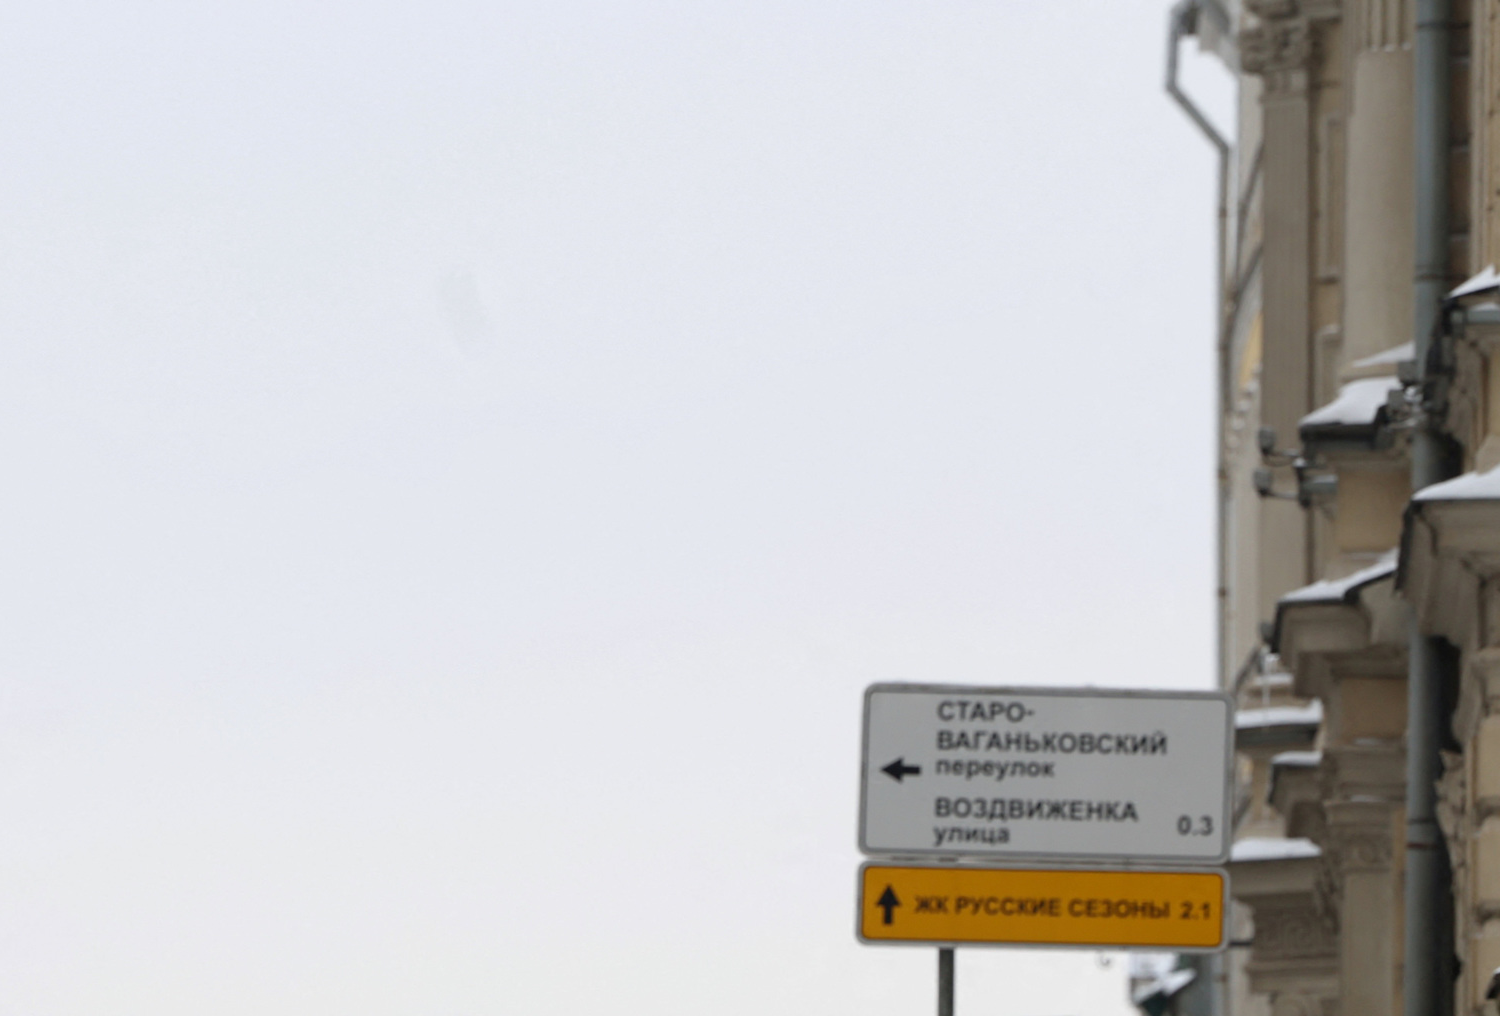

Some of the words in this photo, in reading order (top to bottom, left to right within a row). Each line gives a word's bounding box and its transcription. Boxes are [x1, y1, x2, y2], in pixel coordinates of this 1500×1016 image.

[936, 700, 1035, 724] СТАРО-
[936, 729, 1168, 755] ВАГАНЬКОВСКИЙ
[935, 758, 1055, 781] переулок
[934, 796, 1139, 822] ВОЗДВИЖЕНКА
[933, 825, 1011, 848] улица
[1176, 814, 1215, 837] 0.3
[914, 896, 949, 914] ЖК
[954, 896, 1061, 917] РУССКИЕ
[1067, 898, 1171, 920] СЕЗОНЫ
[1179, 900, 1212, 921] 2.1
